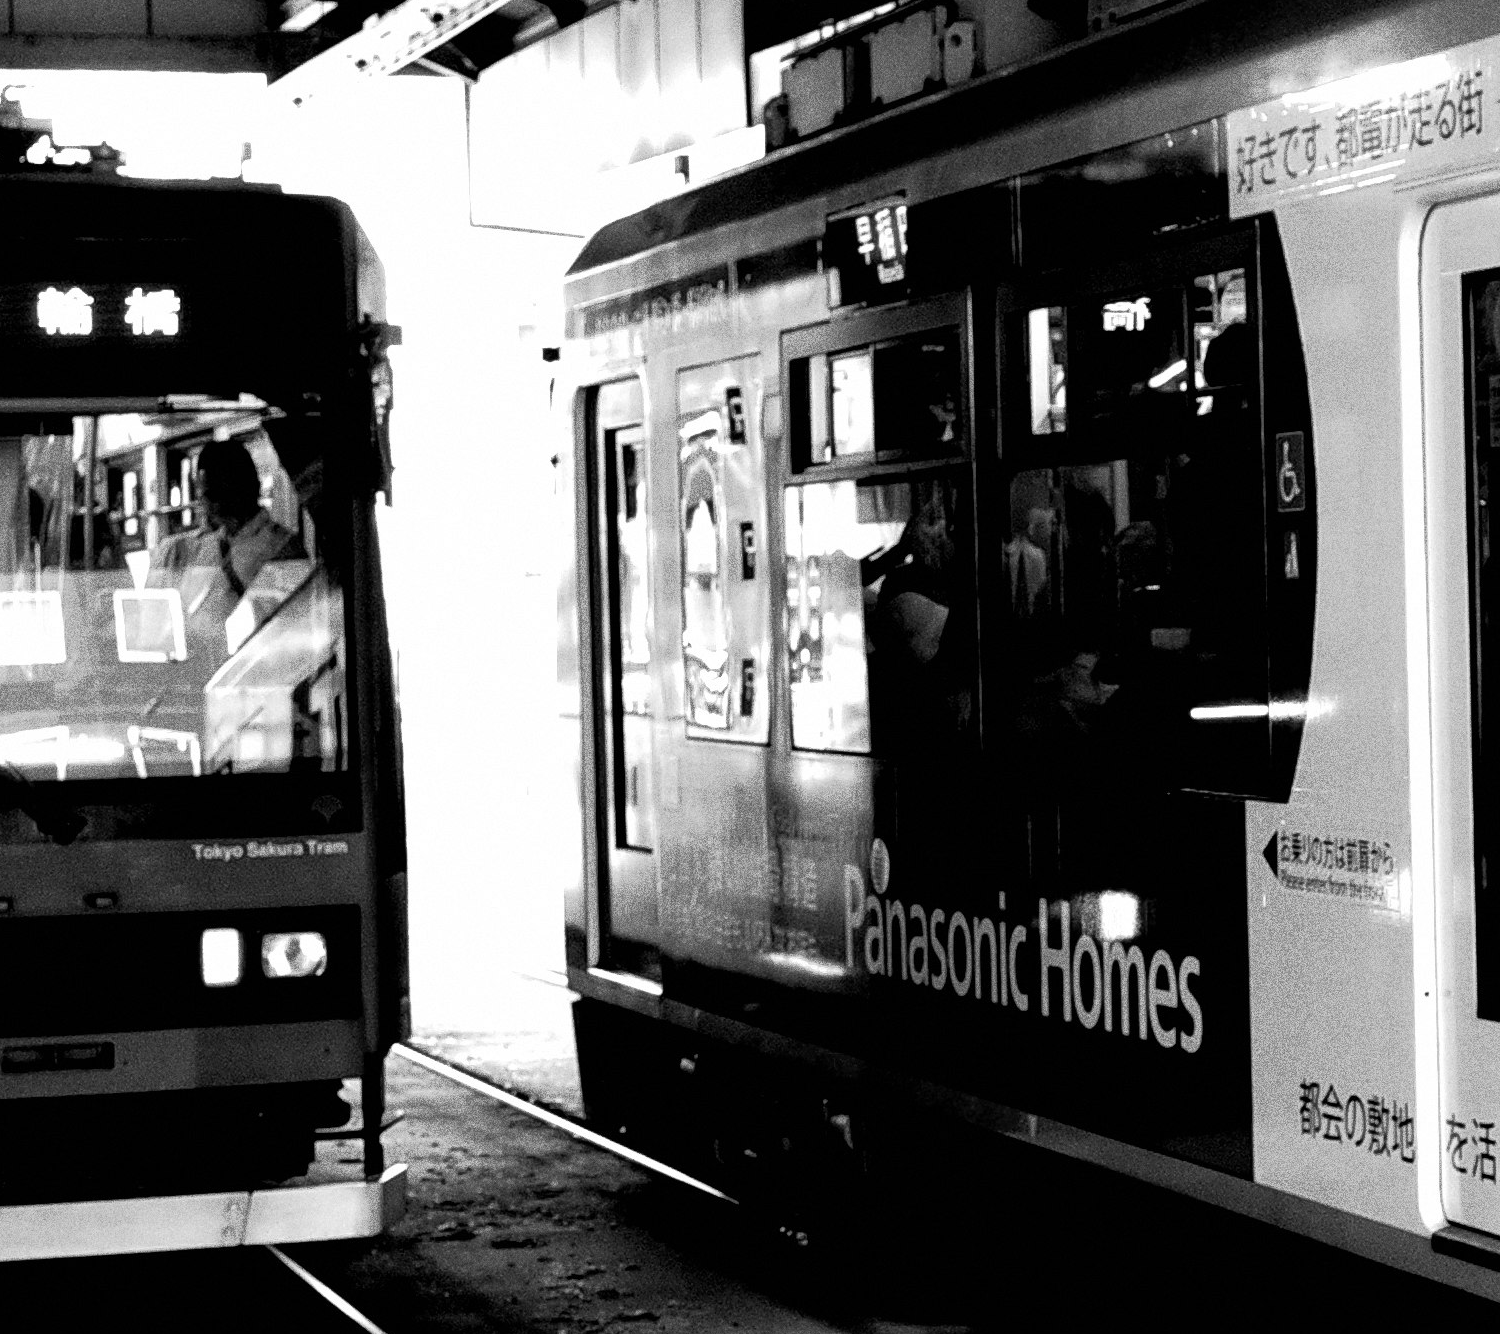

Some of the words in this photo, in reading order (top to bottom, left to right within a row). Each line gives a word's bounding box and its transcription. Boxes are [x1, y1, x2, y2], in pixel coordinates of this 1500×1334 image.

[191, 842, 244, 863] Tokyo
[246, 840, 304, 859] Sakura
[306, 838, 349, 856] Tram
[844, 864, 1029, 1011] Panasonic
[1039, 898, 1204, 1053] Homes
